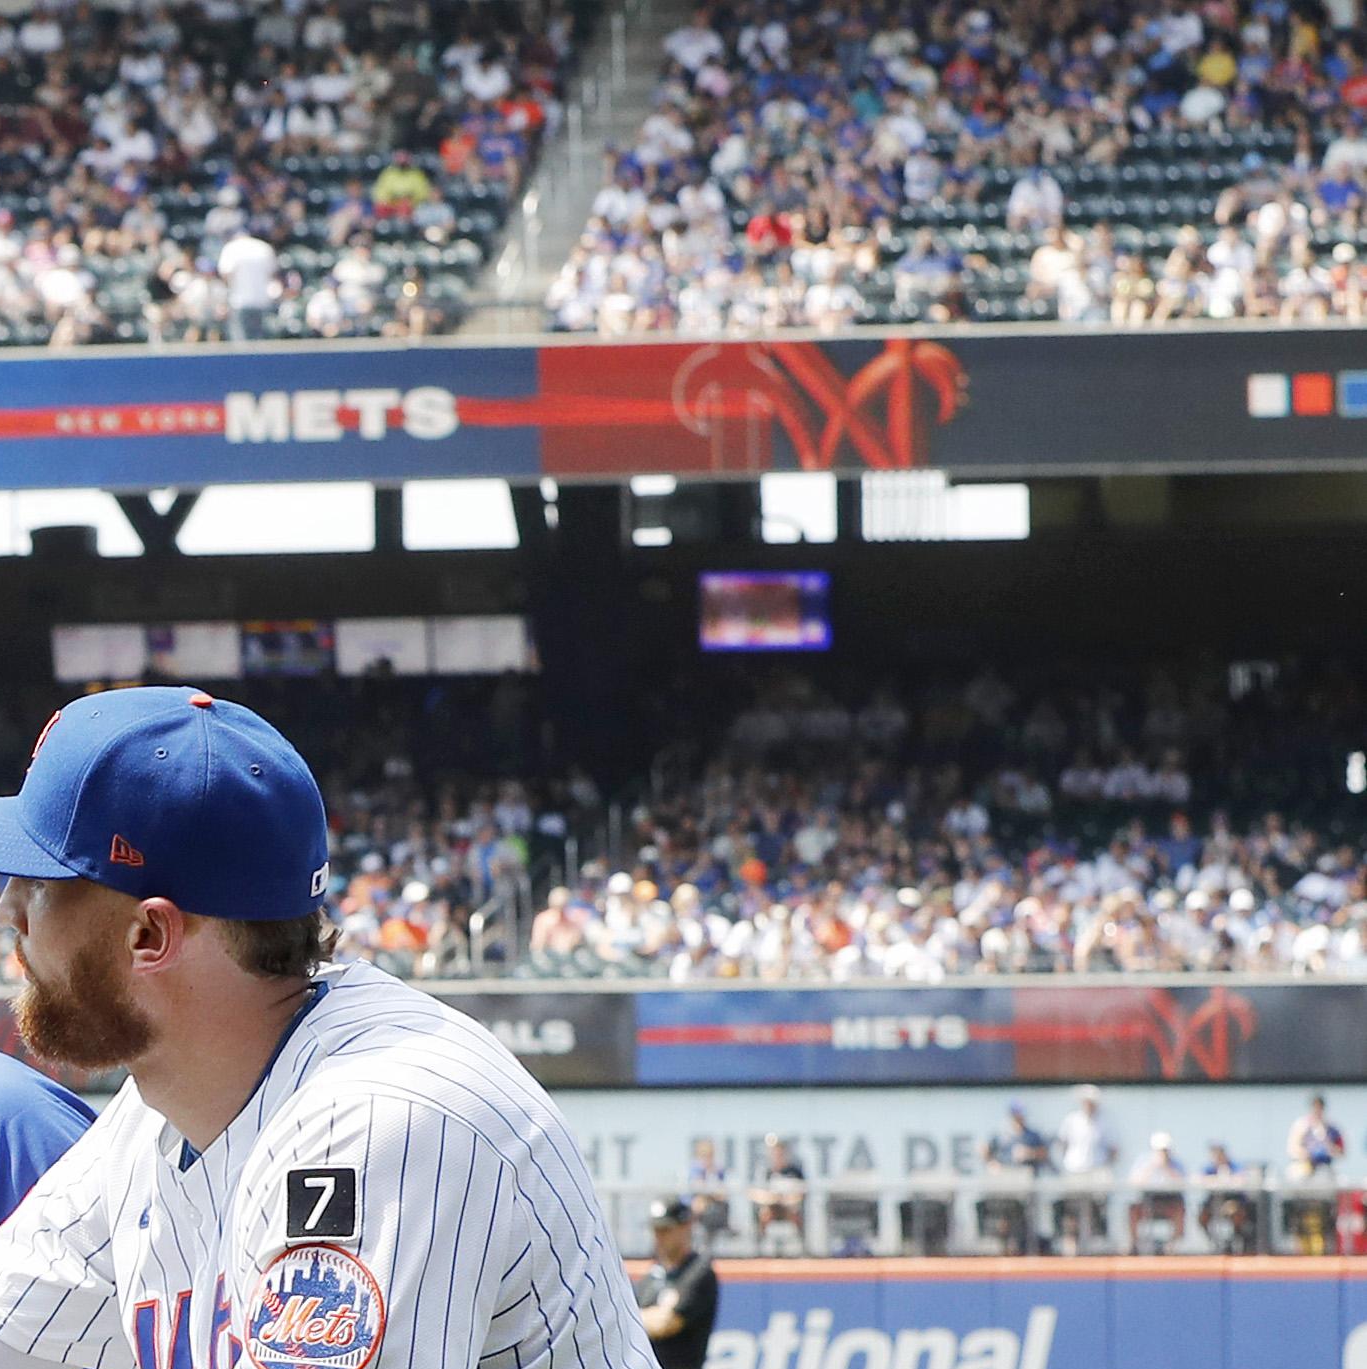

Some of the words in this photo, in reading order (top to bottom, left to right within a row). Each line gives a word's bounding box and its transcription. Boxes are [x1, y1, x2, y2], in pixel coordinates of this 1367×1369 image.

[224, 385, 460, 444] METS
[830, 1015, 968, 1050] METS
[303, 1176, 336, 1231] 7
[259, 1295, 360, 1348] Mets
